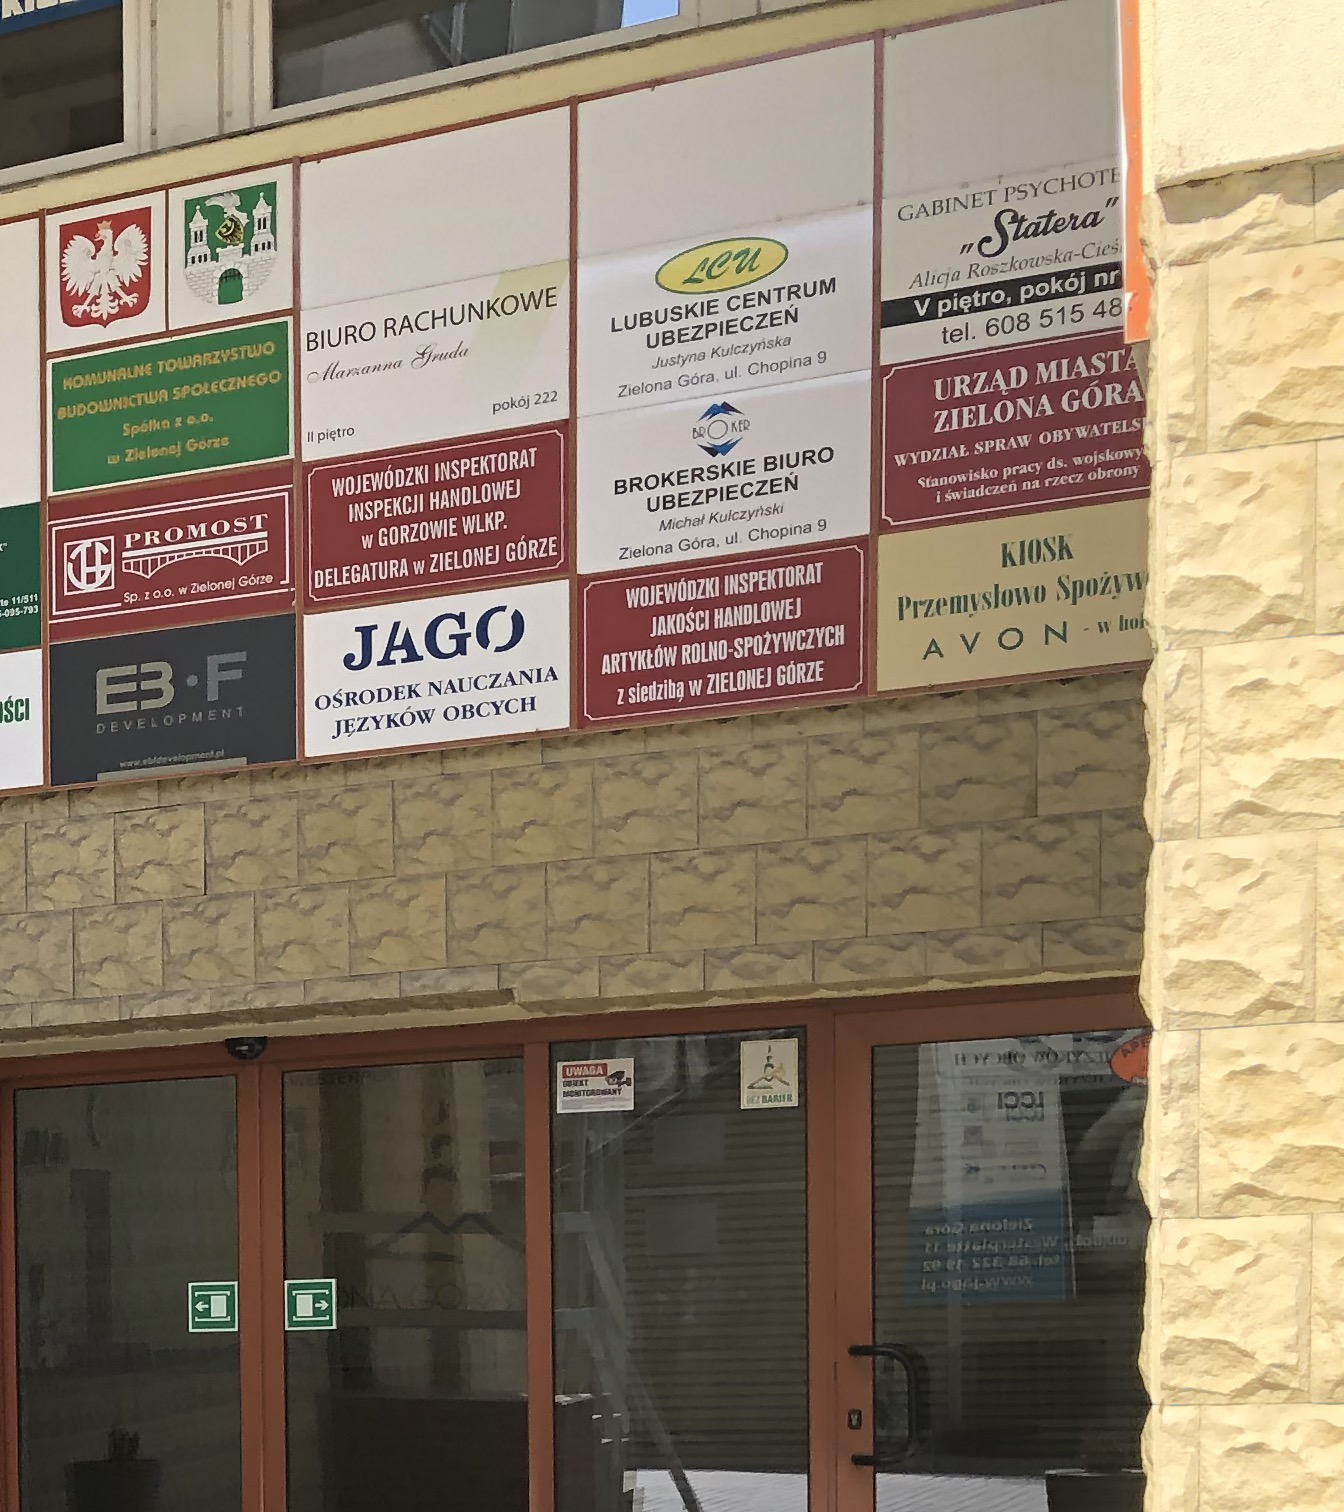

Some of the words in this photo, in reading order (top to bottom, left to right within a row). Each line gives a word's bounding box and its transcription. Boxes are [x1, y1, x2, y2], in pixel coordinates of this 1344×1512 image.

[898, 190, 998, 222] GABINET
[682, 247, 762, 285] LCU
[909, 269, 960, 290] Alicja
[611, 299, 719, 333] LUBUSKIE
[726, 277, 836, 312] CENTRUM
[914, 301, 931, 316] V
[937, 286, 1011, 318] piętro,
[1020, 274, 1086, 302] pokój
[1093, 269, 1120, 288] nr
[307, 321, 376, 352] BIURO
[384, 286, 558, 338] RACHUNKOWE
[647, 304, 798, 349] UBEZPIECZEŃ
[942, 322, 976, 345] tel.
[985, 312, 1031, 337] 608
[1039, 304, 1084, 327] 515
[1093, 298, 1122, 319] 48
[63, 363, 152, 390] KOMUNALNE
[158, 341, 275, 373] TOWARZYSTWO
[307, 359, 403, 384] Marzanna
[411, 341, 469, 369] Gruda
[652, 351, 706, 370] Justyna
[710, 335, 791, 359] Kulczyńska
[57, 389, 168, 420] BUDOWNICTWA
[173, 371, 282, 400] SPOŁECZNEGO
[492, 396, 531, 415] pokój
[534, 391, 558, 405] 222
[934, 366, 1028, 401] URZĄD
[933, 395, 1054, 434] ZIELONA
[1061, 380, 1144, 412] GÓRA
[318, 426, 355, 443] piętro
[692, 419, 751, 440] BROKER
[894, 444, 969, 467] WYDZIAŁ
[974, 434, 1032, 455] SPRAW
[332, 465, 429, 498] WOJEWÓDZKI
[435, 447, 537, 483] INSPEKTORAT
[614, 458, 756, 495] BROKERSKIE
[764, 446, 834, 472] BIURO
[349, 493, 424, 523] INSPEKCJI
[430, 479, 521, 511] HANDLOWEJ
[647, 471, 798, 513] UBEZPIECZEŃ
[124, 513, 268, 548] PROMOST
[659, 514, 706, 532] Michał
[709, 503, 784, 525] Kulczyński
[619, 543, 673, 561] Zielona
[678, 534, 719, 551] Góra,
[725, 531, 741, 545] ul.
[748, 524, 812, 542] Chopina
[817, 518, 827, 532] 9
[1001, 534, 1074, 568] KIOSK
[626, 577, 719, 609] WOJEWÓDZKI
[724, 562, 824, 596] INSPEKTORAT
[343, 605, 525, 671] JAGO
[650, 607, 709, 637] JAKOŚCI
[714, 597, 802, 629] HANDLOWEJ
[601, 645, 677, 675] ARTYKŁÓW
[681, 625, 845, 666] ROLNO-SPOŻYWCZYCH
[922, 621, 1068, 661] AVON
[314, 682, 422, 711] OŚRODEK
[428, 666, 558, 696] NAUCZANIA
[97, 706, 243, 734] DEVELOPMENT
[332, 706, 436, 740] JĘZYKÓW
[443, 696, 537, 722] OBCYCH
[565, 1065, 603, 1076] UWAGA
[761, 1094, 793, 1104] BARIER
